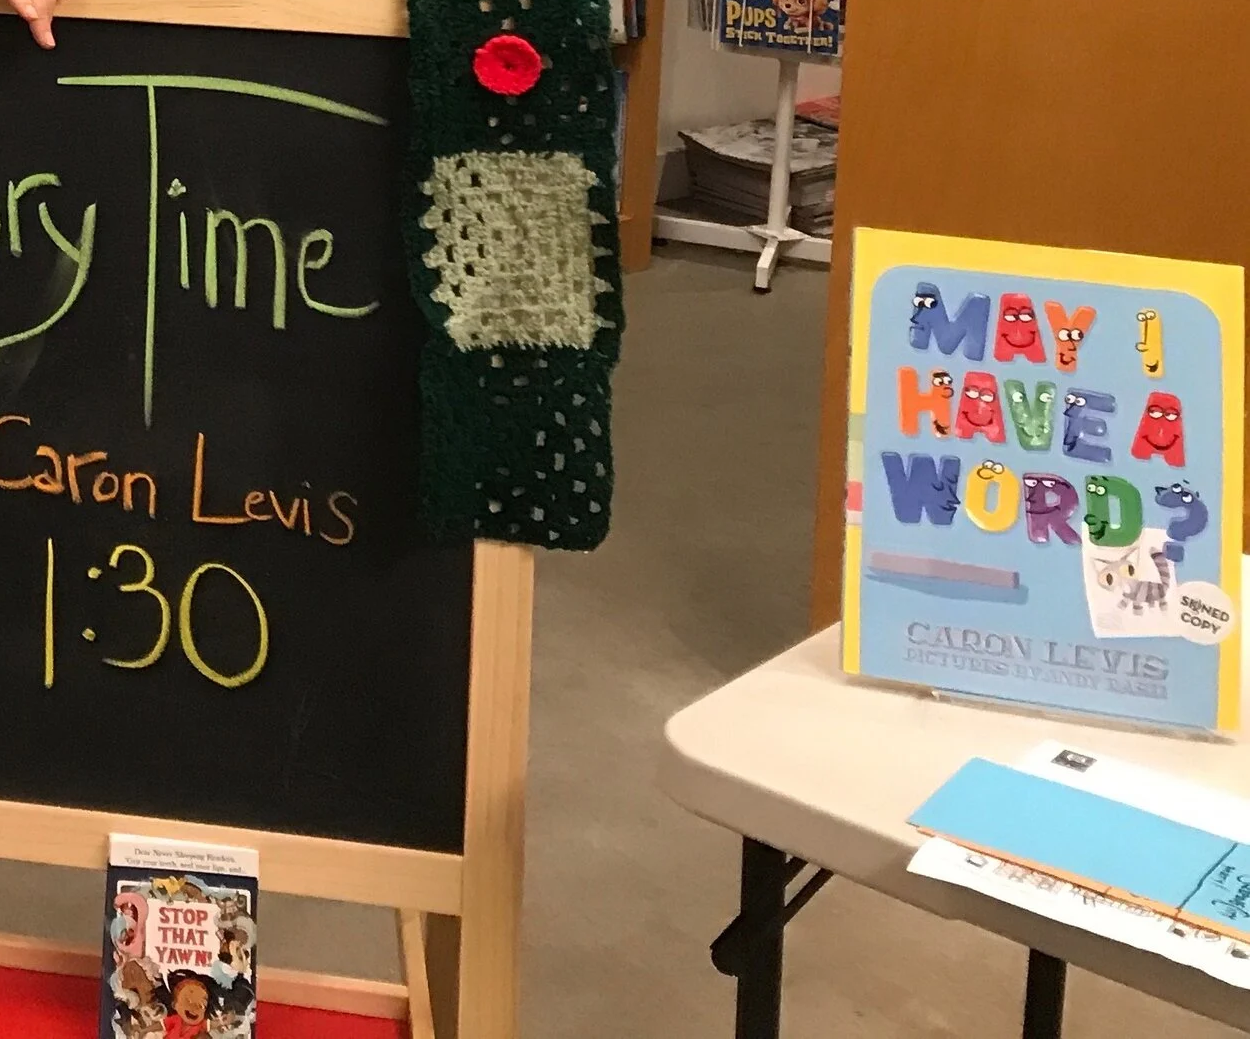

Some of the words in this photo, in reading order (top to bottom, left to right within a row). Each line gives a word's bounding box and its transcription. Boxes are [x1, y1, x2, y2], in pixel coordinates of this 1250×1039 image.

[726, 0, 777, 27] PUPS
[57, 75, 388, 429] Time
[909, 282, 1096, 374] MAY
[1135, 307, 1165, 379] I
[897, 366, 1116, 464] HAVE
[1131, 391, 1186, 468] A
[192, 433, 358, 546] Levis
[881, 452, 1208, 563] WORD?
[43, 537, 269, 690] 1:30
[1180, 595, 1230, 623] SIGNED
[1180, 611, 1221, 635] COPY
[905, 621, 1033, 660] CARON
[1039, 640, 1169, 682] LEVIS
[158, 927, 208, 946] THAT
[160, 907, 208, 926] STOP
[155, 946, 212, 967] YAWN!
